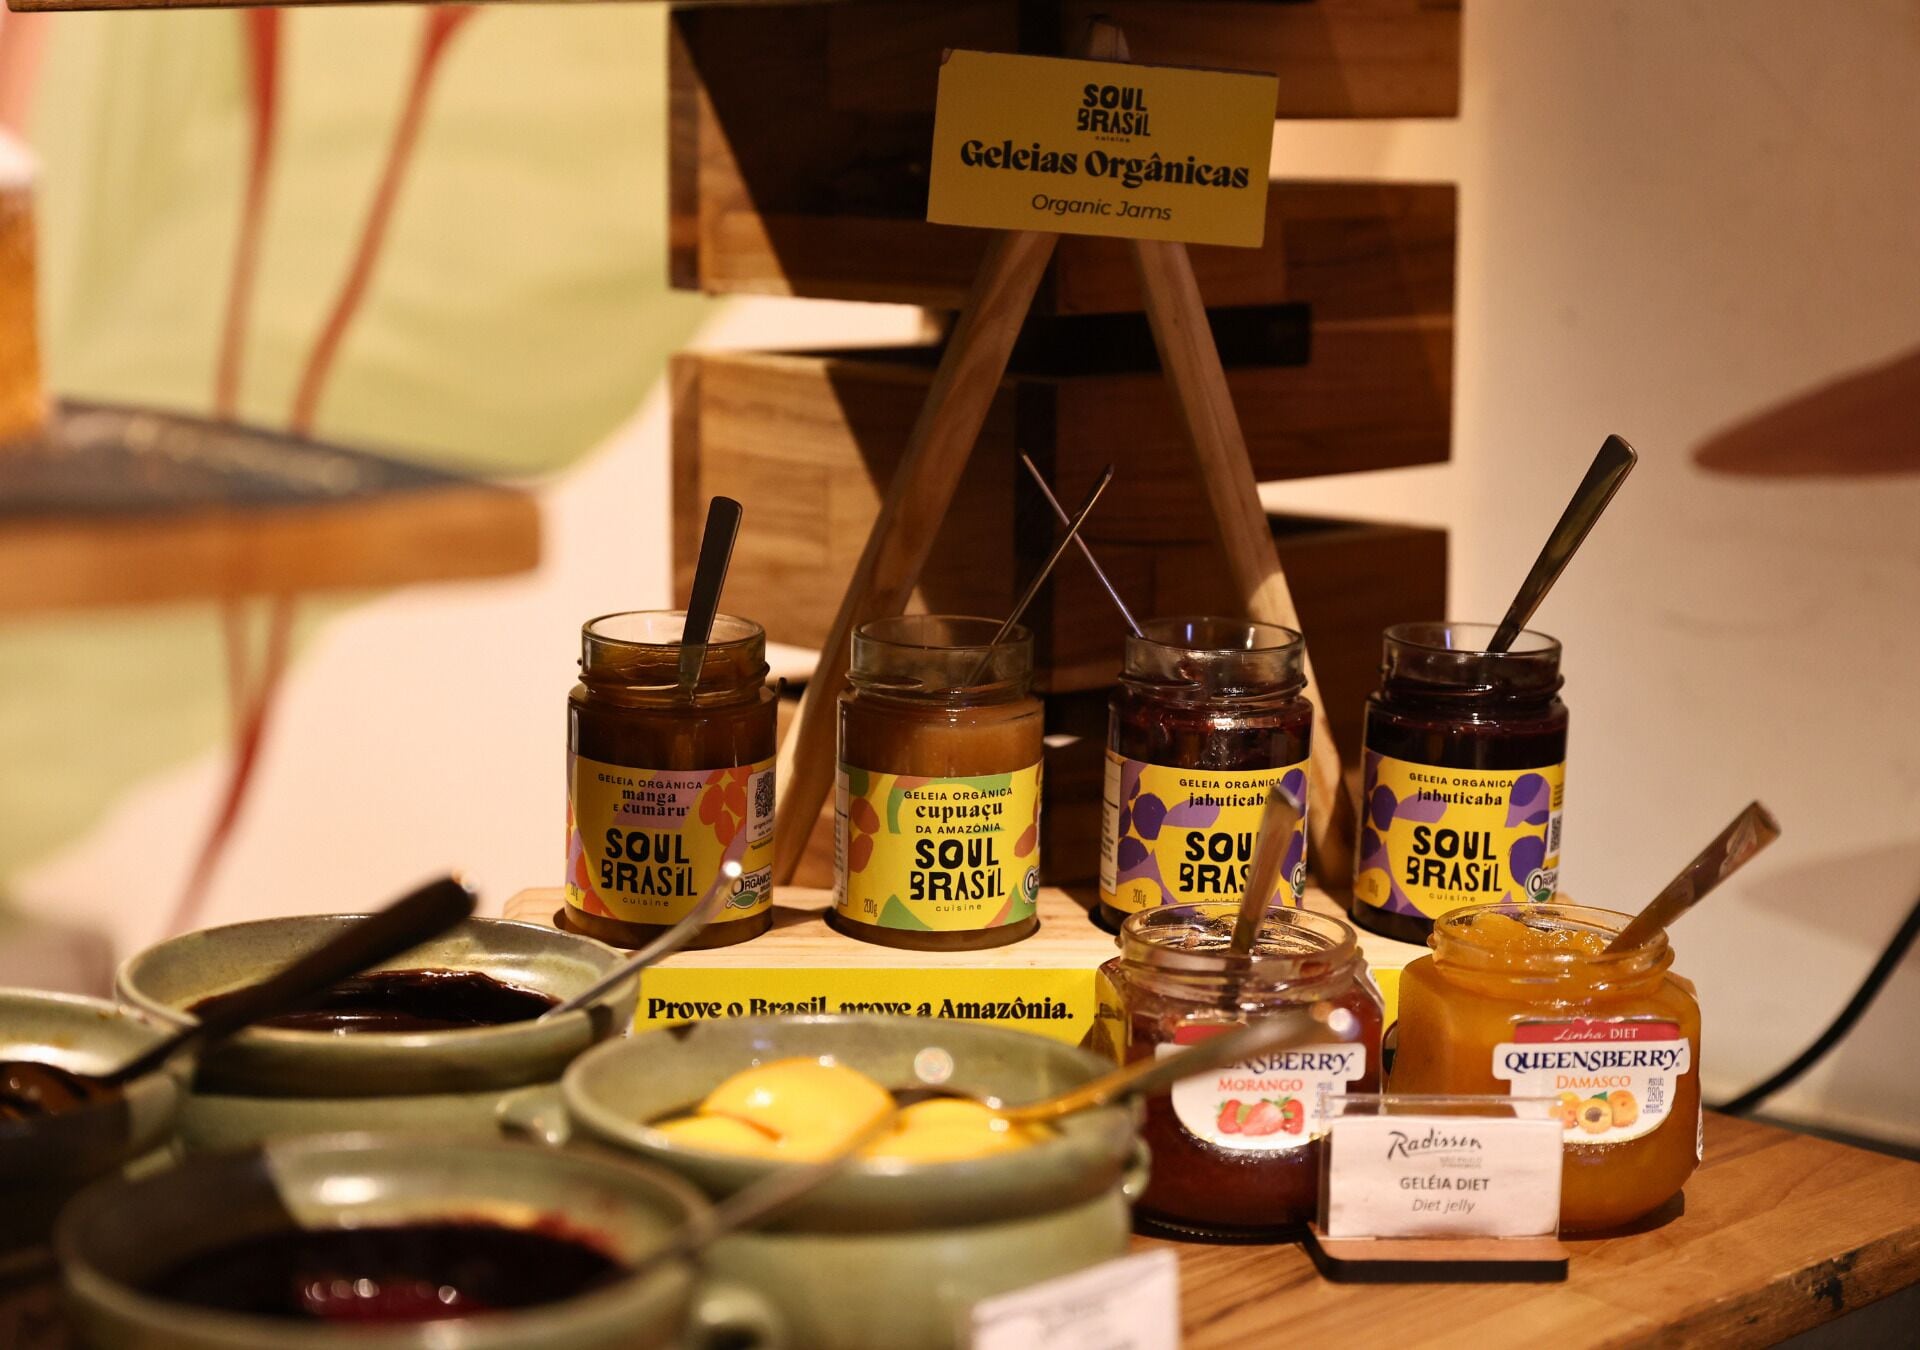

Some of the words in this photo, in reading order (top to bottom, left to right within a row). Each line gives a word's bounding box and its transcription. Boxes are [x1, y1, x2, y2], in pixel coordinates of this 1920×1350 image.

[1082, 83, 1147, 112] SOUL
[960, 139, 1078, 175] Geleias
[1084, 150, 1249, 189] Orgânicas
[1031, 193, 1110, 216] Organic
[1116, 200, 1172, 221] Jams
[598, 772, 634, 787] GELEIA
[1179, 778, 1220, 789] GELEIA
[1409, 772, 1448, 785] GELEIA
[1452, 776, 1513, 788] ORGÂNICA
[622, 788, 677, 806] manga
[903, 790, 948, 801] GELEIA
[952, 787, 1013, 801] ORGÂNICA
[1189, 792, 1268, 808] jabuticab
[1417, 787, 1502, 806] jabuticaba
[613, 803, 619, 812] E
[915, 802, 1003, 823] cupuaçu
[915, 825, 932, 834] DA
[936, 822, 1001, 834] AMAZÔNIA
[605, 827, 690, 864] SOUL
[1185, 831, 1260, 863] SOU
[1412, 825, 1497, 860] SOUL
[914, 837, 999, 869] SOUL
[1179, 862, 1251, 894] BRAS
[622, 897, 670, 907] cuisine
[1428, 892, 1476, 903] cuisine
[935, 903, 982, 912] cuisine
[647, 998, 721, 1020] Prove
[727, 1002, 744, 1019] o
[917, 1002, 932, 1018] a
[938, 996, 1074, 1020] Amazônia.
[1553, 1029, 1606, 1041] Linha
[1609, 1027, 1639, 1039] DIET
[1505, 1047, 1684, 1073] QUEENSBERRY
[1217, 1077, 1304, 1092] MORANGO
[1556, 1075, 1631, 1089] DAMASCO
[1647, 1086, 1664, 1105] 280g
[1387, 1127, 1483, 1160] Radisson
[1399, 1174, 1451, 1191] GELÉIA
[1456, 1177, 1490, 1191] DIET
[1411, 1199, 1442, 1213] Diet
[1444, 1199, 1476, 1215] jelly
